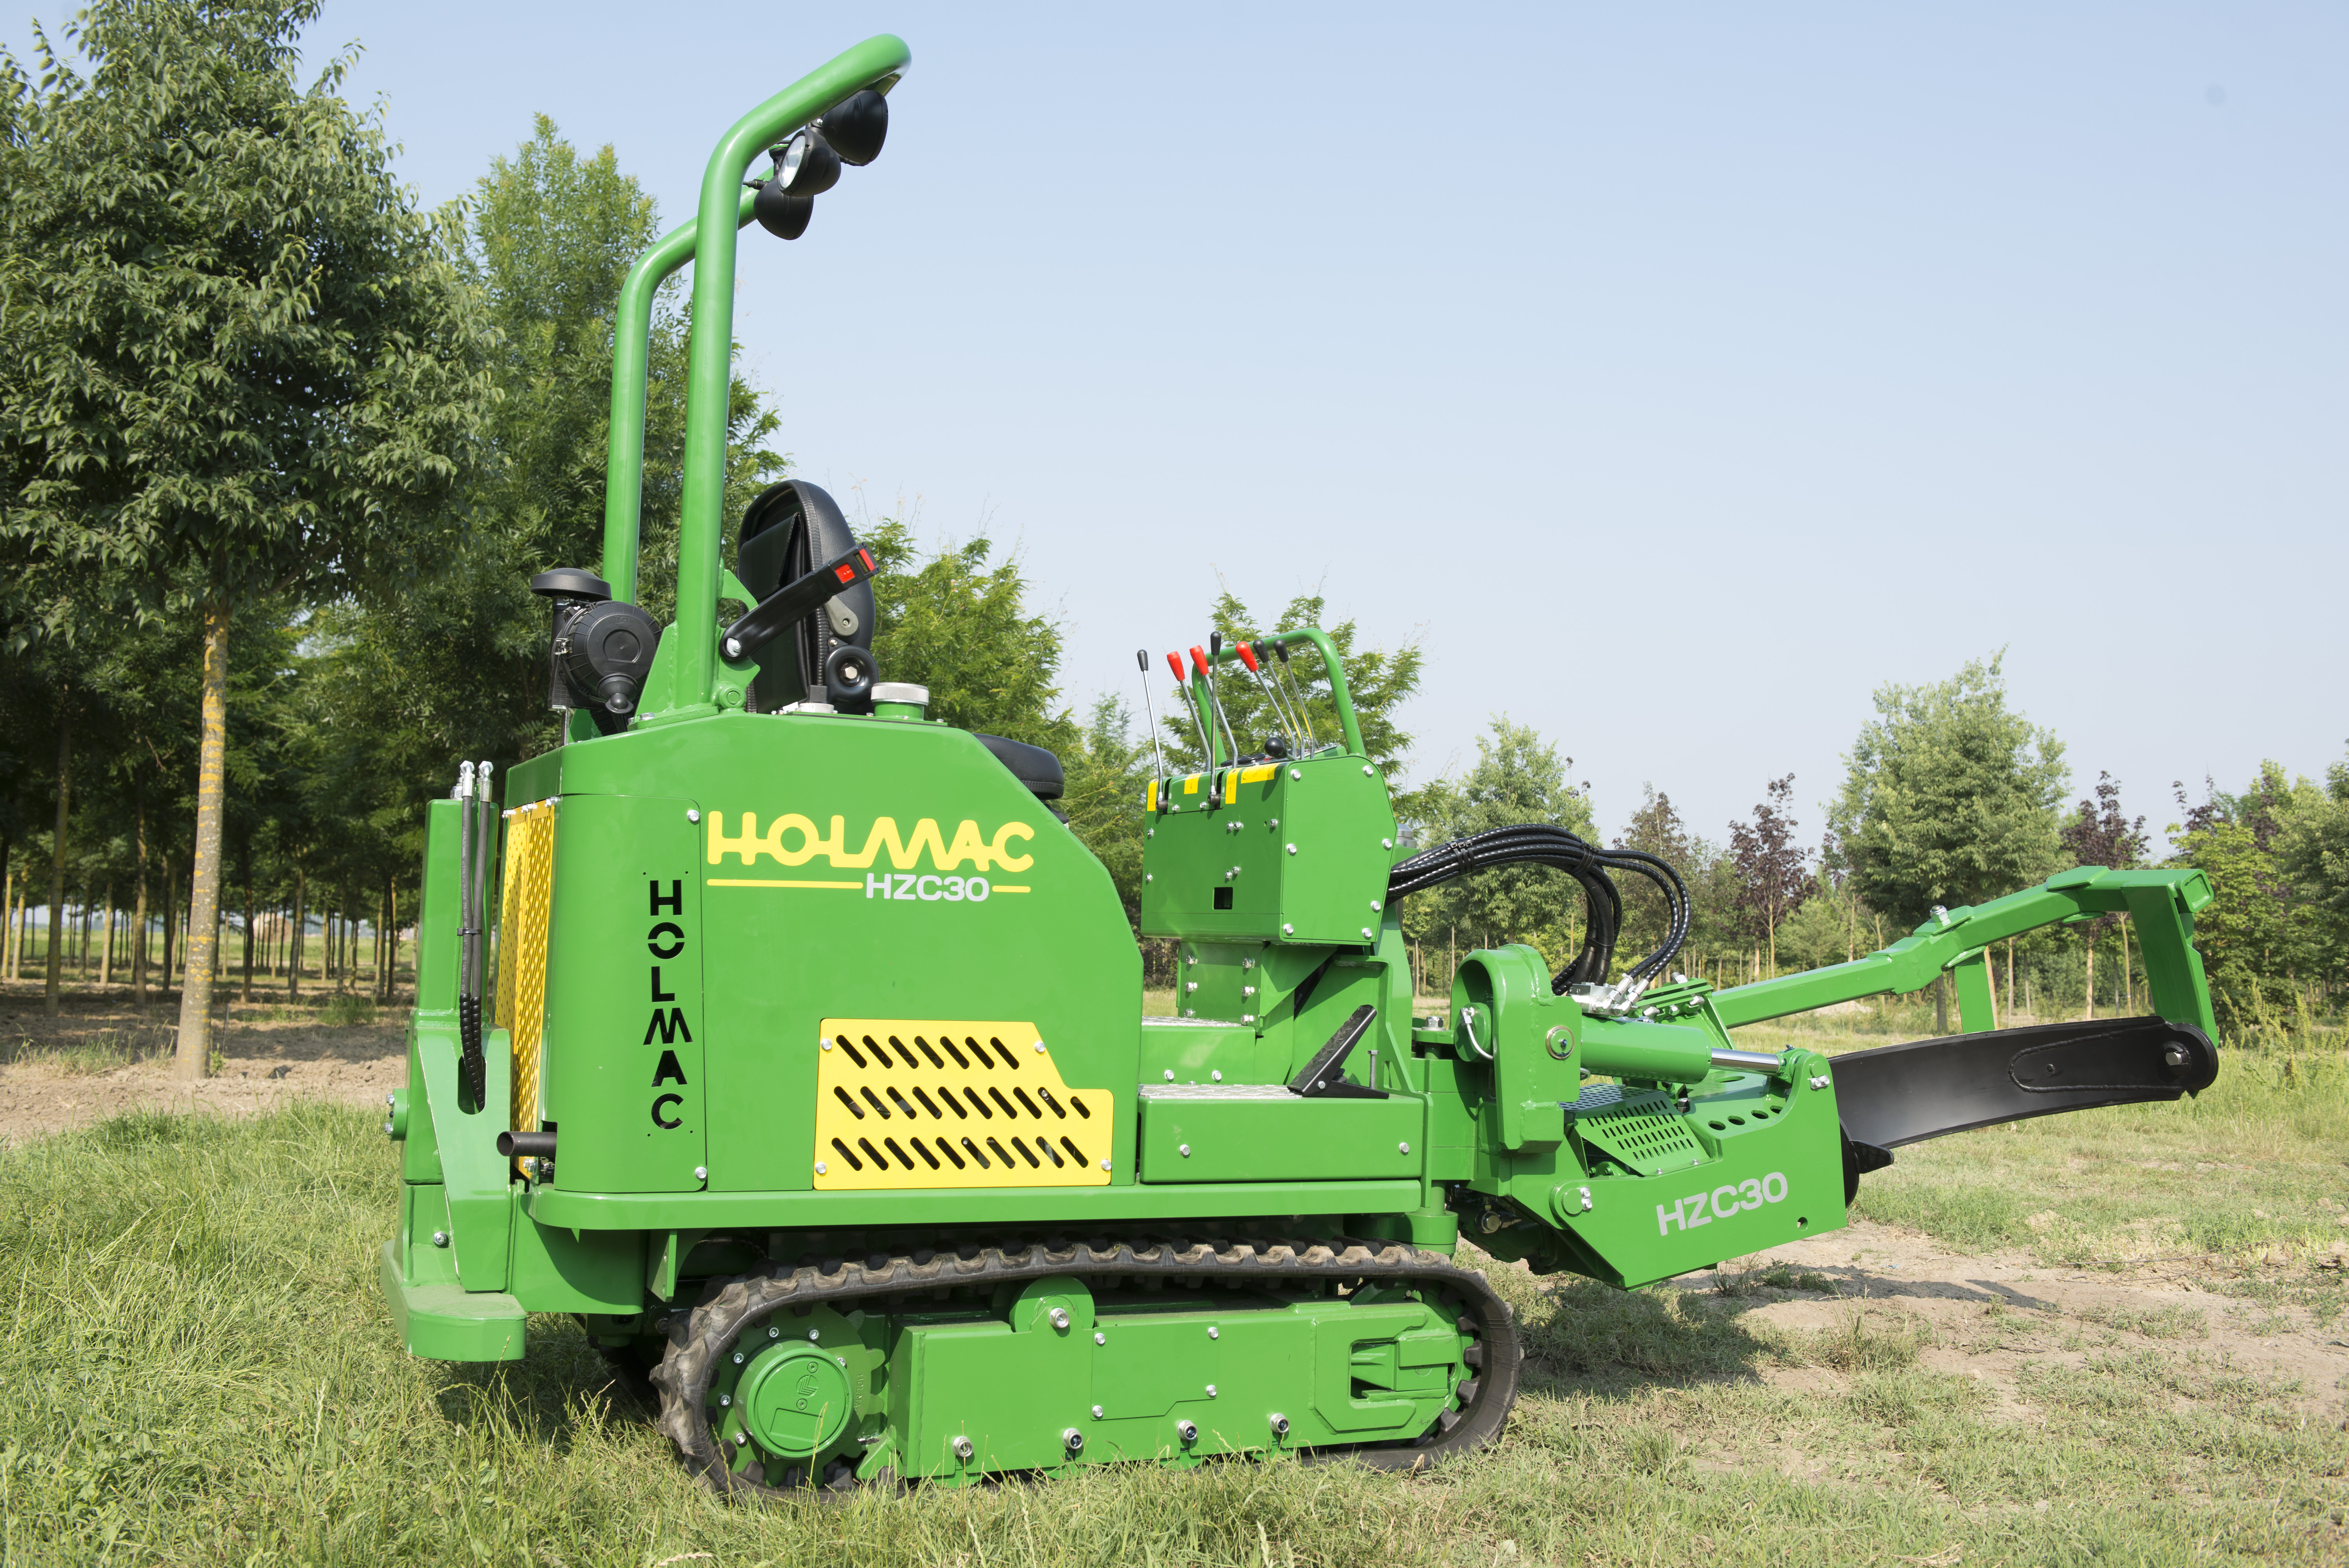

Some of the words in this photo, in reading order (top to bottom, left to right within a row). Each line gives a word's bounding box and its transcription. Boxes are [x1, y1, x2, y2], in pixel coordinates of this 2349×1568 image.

[708, 811, 1034, 872] HOLMAC
[866, 873, 989, 902] HZC30
[643, 880, 693, 1130] HOLMAC
[1656, 1172, 1788, 1236] HZC30
